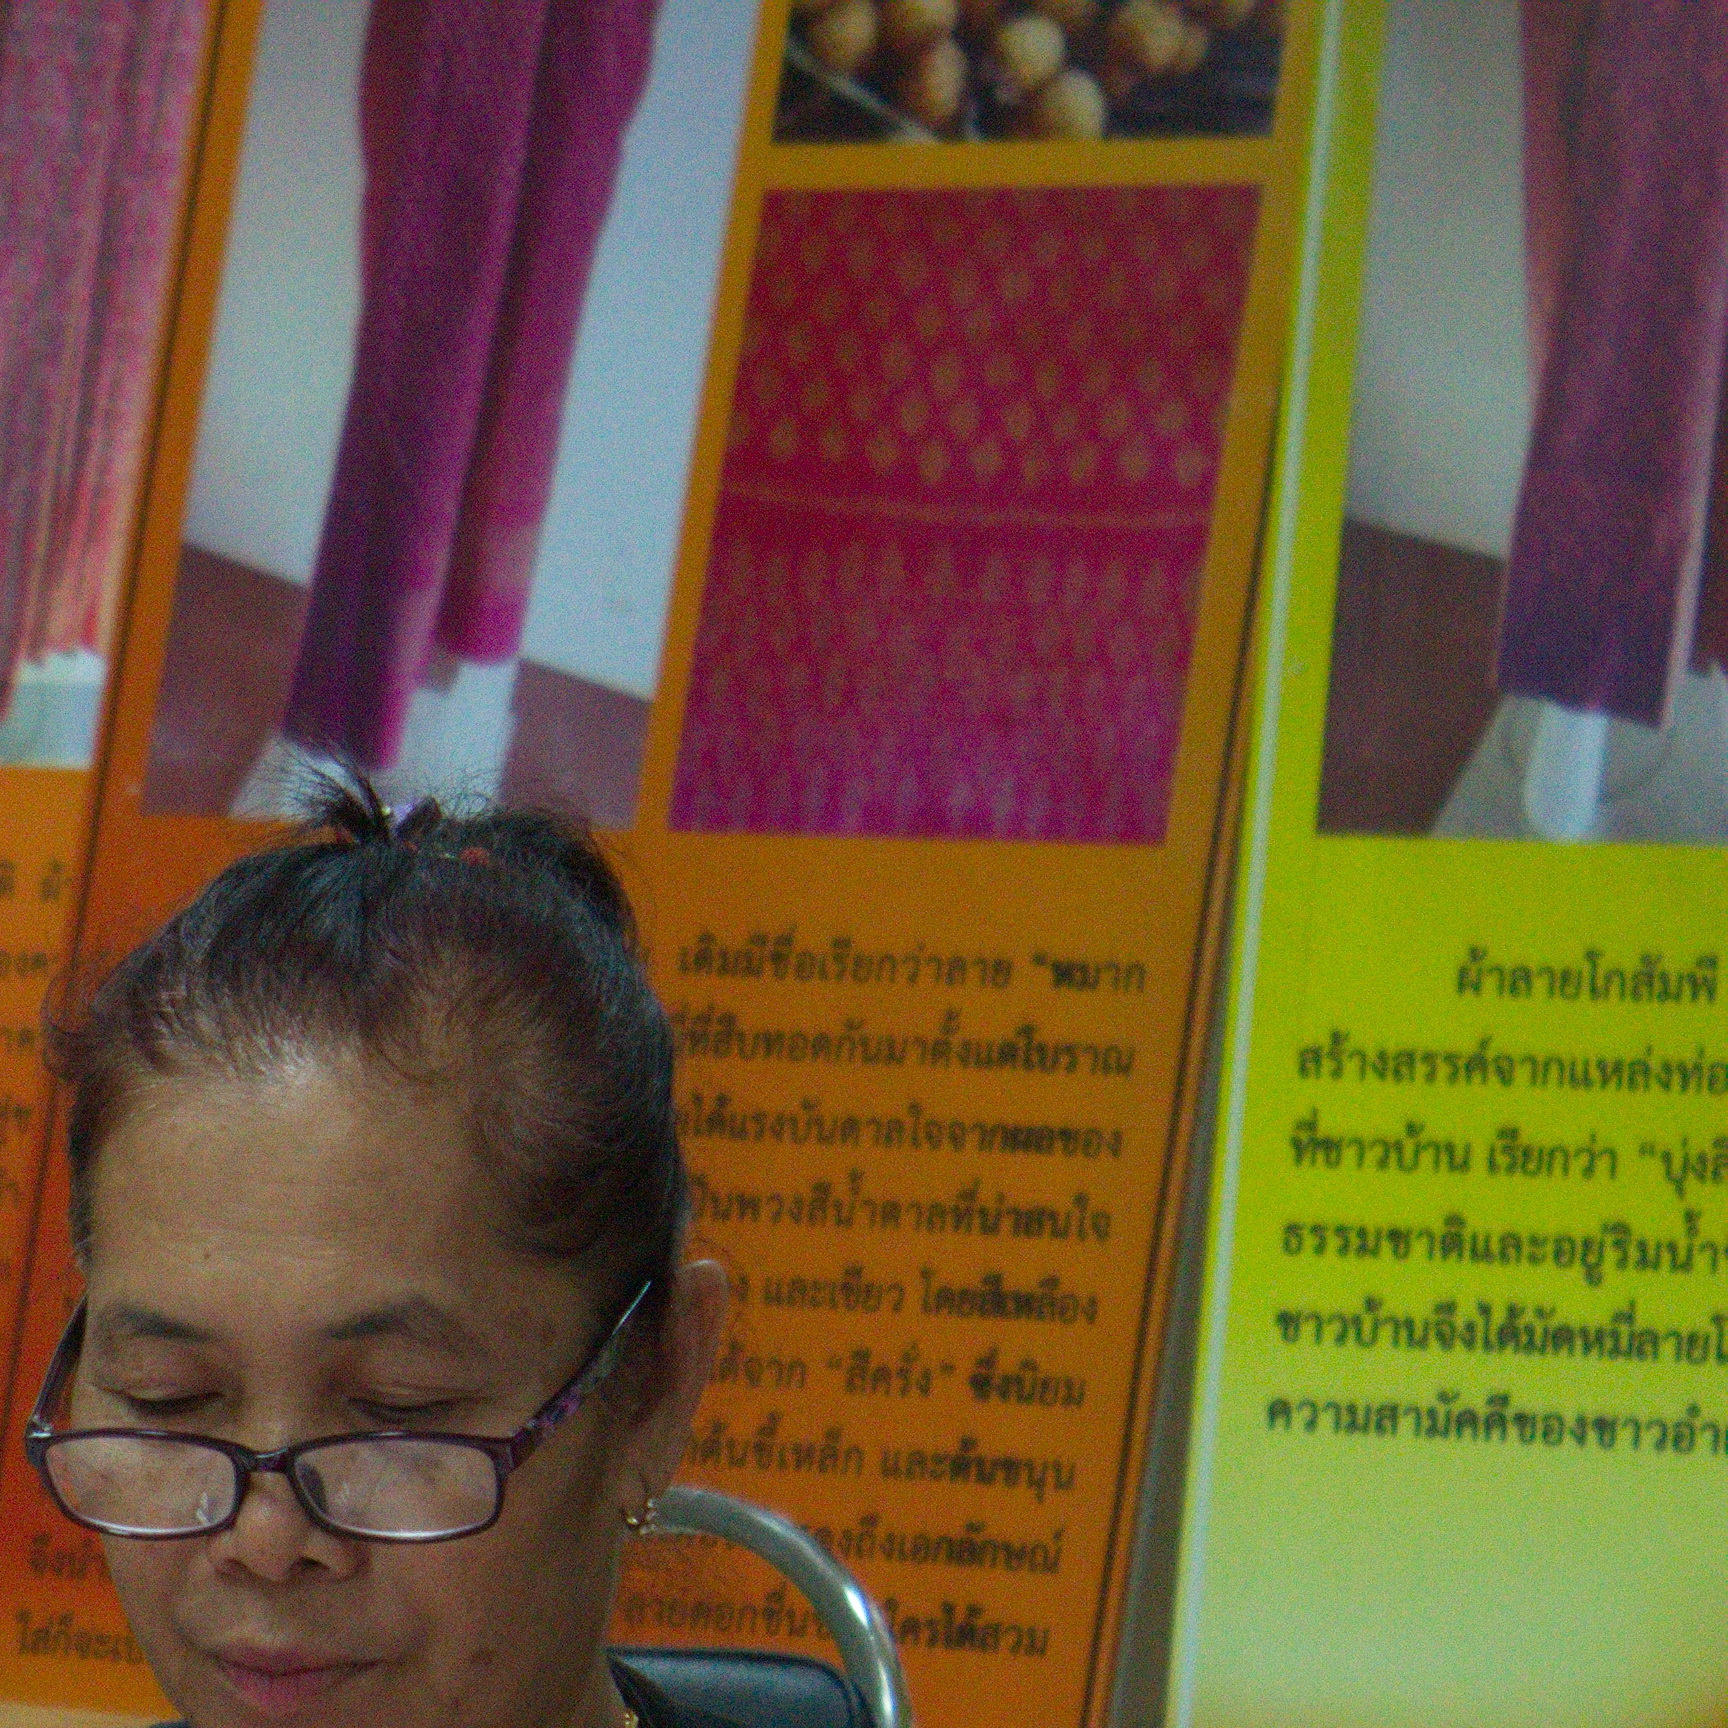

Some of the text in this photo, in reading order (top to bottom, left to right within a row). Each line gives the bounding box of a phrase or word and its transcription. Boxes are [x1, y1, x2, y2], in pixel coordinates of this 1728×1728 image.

[1455, 944, 1719, 1004] ผ้าลายโกสัมพี
[1280, 1210, 1728, 1285] ธรรมชาติและอยู่ริมน้ำ
[710, 1339, 808, 1389] ด้จาก
